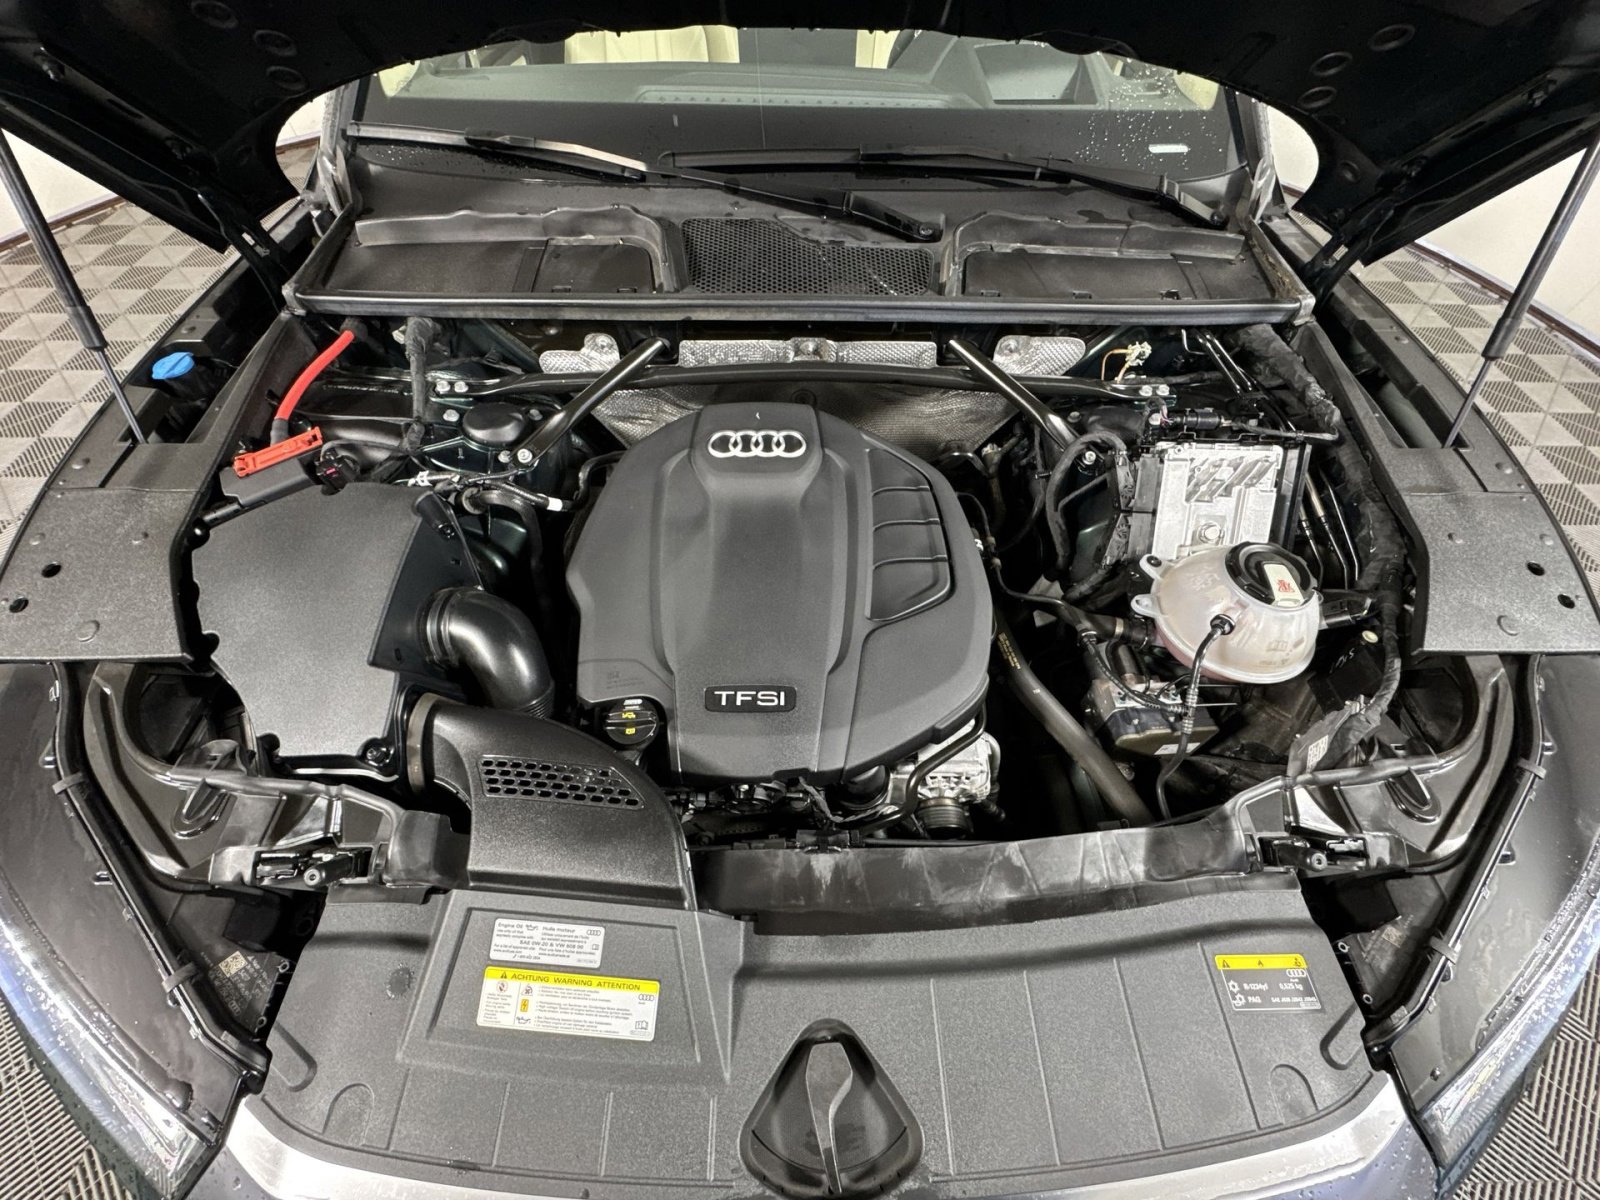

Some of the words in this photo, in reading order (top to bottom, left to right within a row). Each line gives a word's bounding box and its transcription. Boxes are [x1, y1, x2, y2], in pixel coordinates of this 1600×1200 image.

[714, 691, 785, 706] TFSI
[511, 973, 549, 983] ACHTUNG
[554, 977, 592, 987] WARNING
[597, 981, 640, 991] ATTENTION
